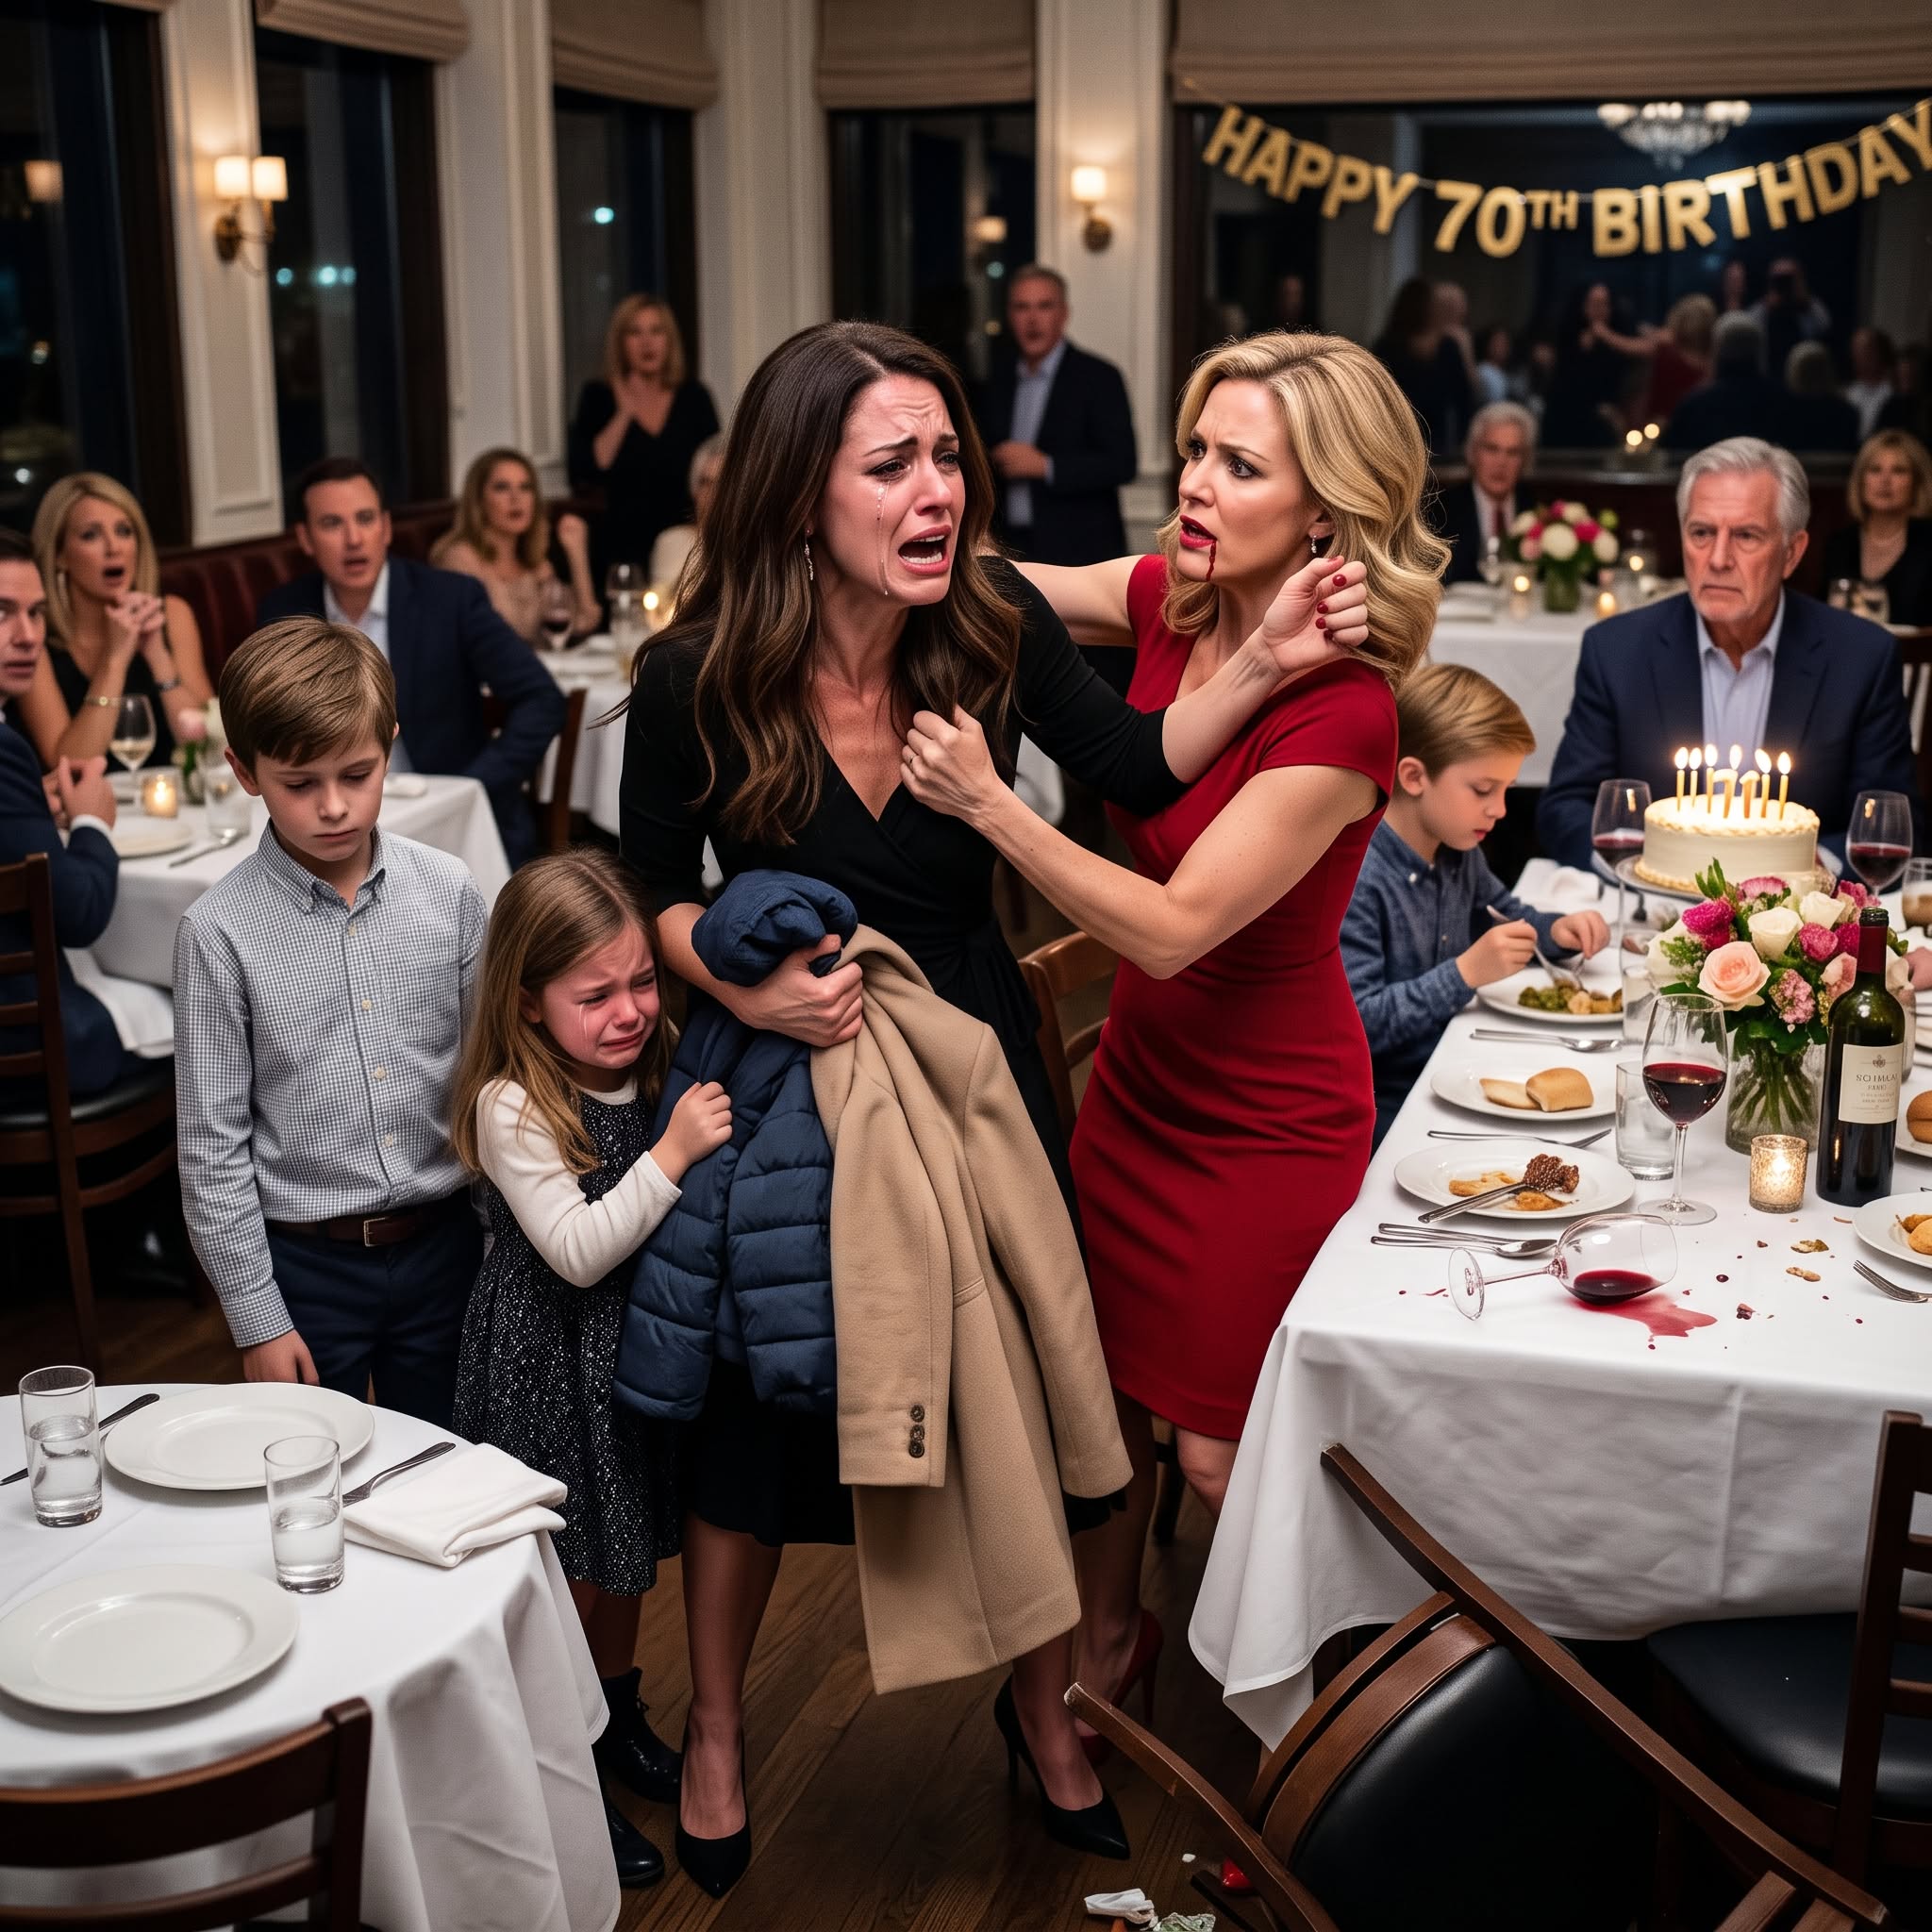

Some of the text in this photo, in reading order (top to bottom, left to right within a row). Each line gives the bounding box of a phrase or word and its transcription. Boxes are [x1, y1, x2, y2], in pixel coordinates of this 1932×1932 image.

[1203, 98, 1932, 258] HAPPY 70TH BIRTHDAY
